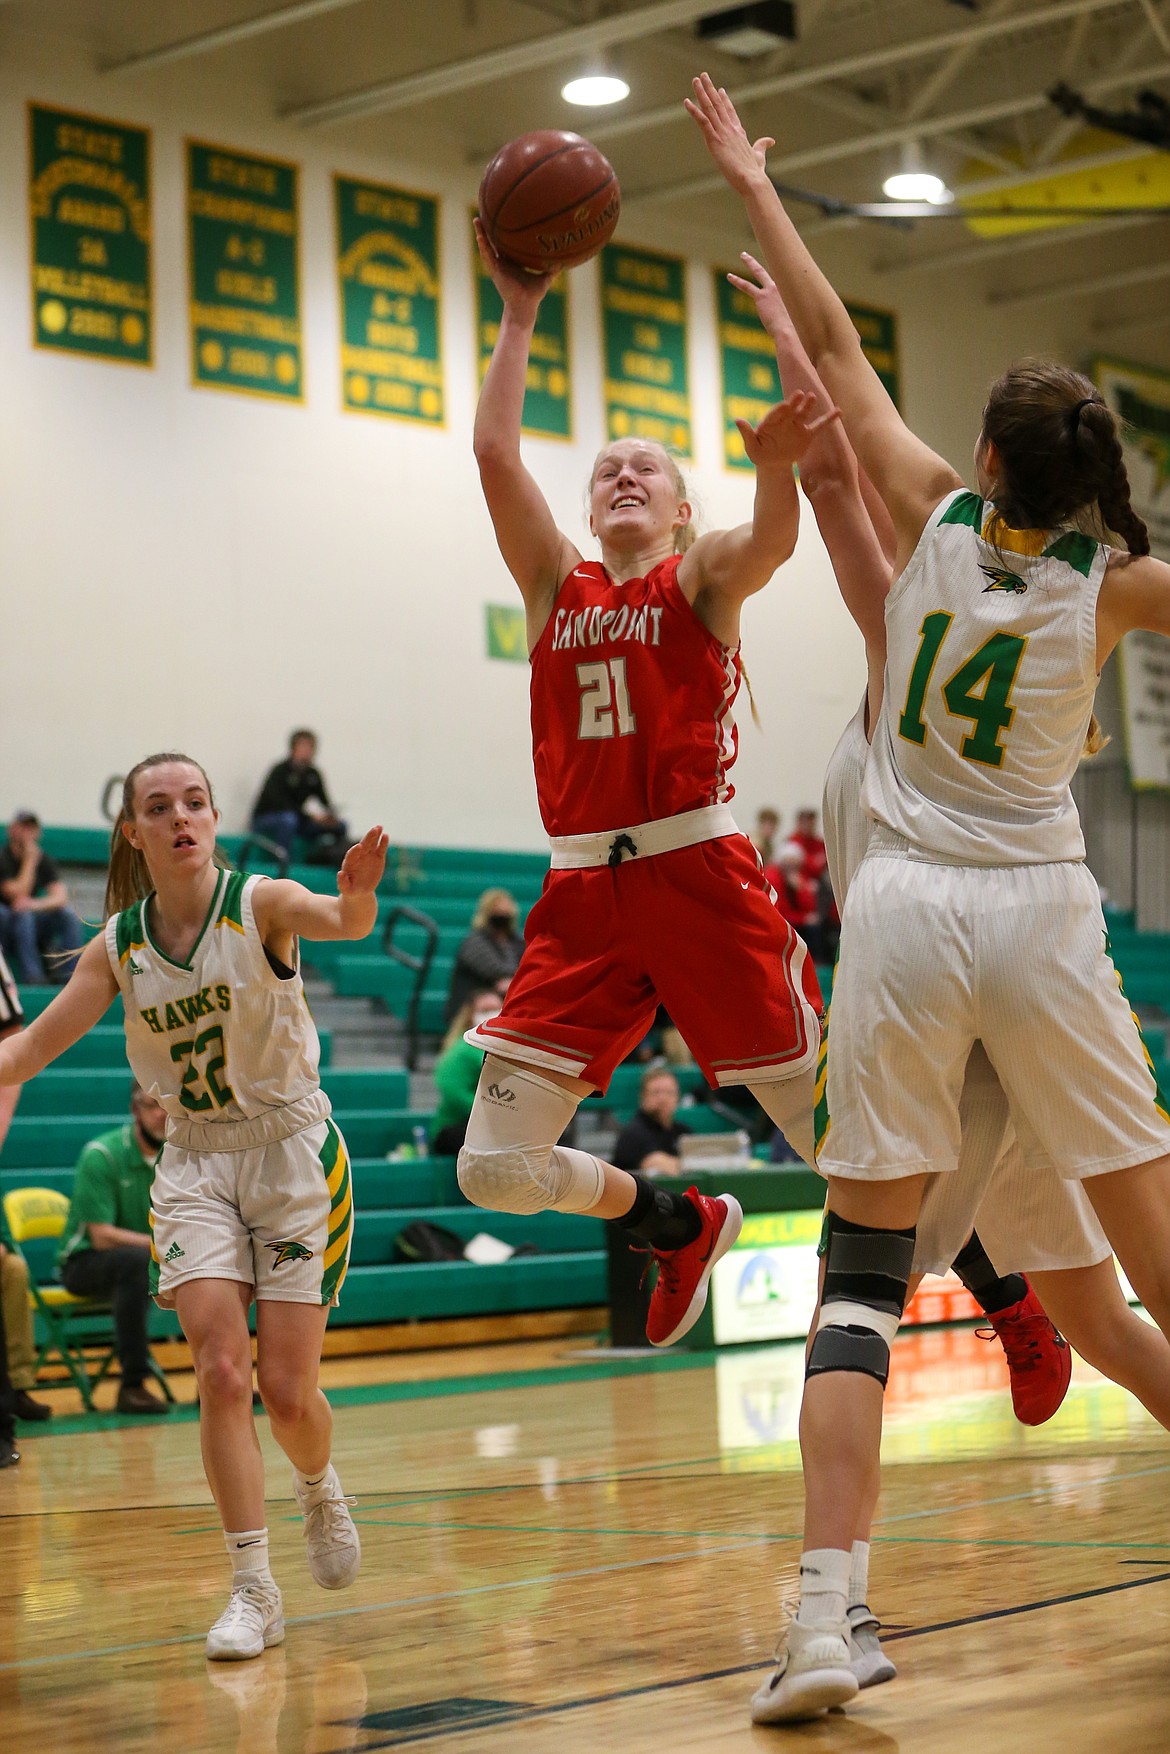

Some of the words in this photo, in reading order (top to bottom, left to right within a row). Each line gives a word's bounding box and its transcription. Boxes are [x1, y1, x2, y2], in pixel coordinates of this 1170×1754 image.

[552, 603, 664, 652] SANDPOINT
[575, 655, 637, 741] 21
[898, 608, 1030, 770] 14
[140, 984, 232, 1034] HAWKS
[169, 1023, 239, 1113] 22
[165, 1250, 186, 1264] adidas
